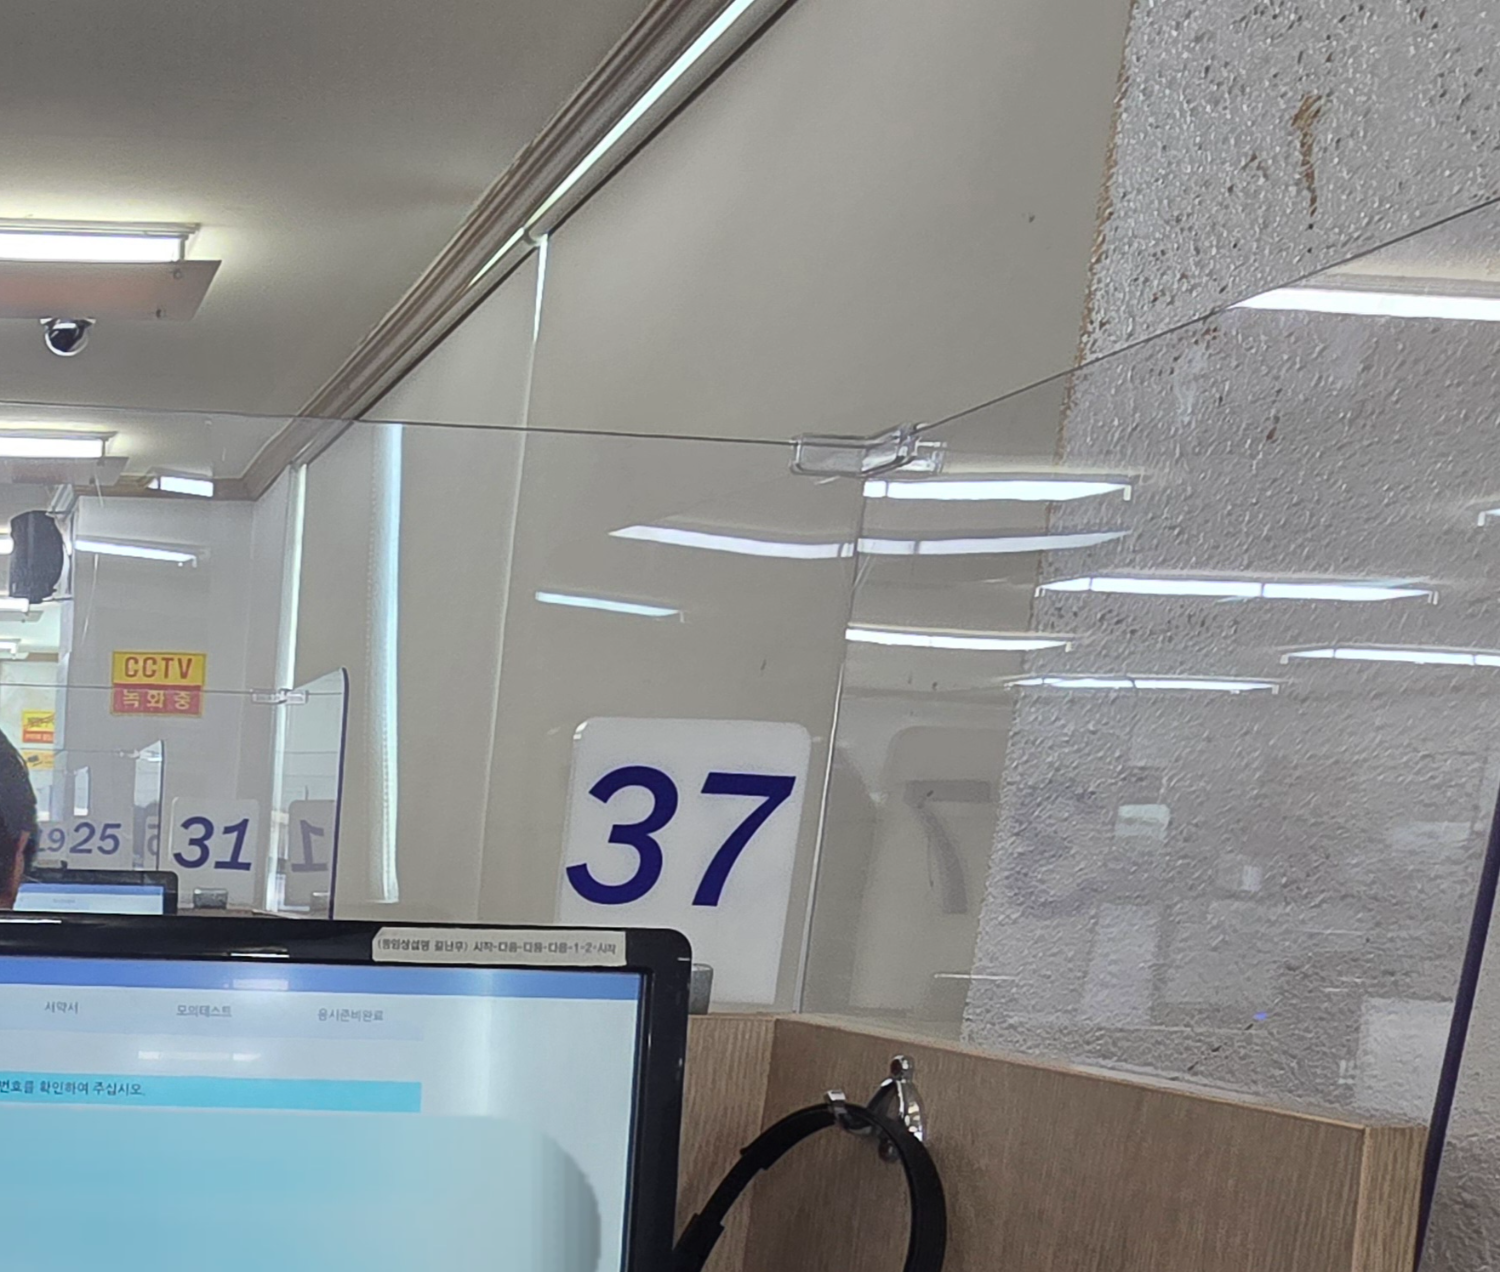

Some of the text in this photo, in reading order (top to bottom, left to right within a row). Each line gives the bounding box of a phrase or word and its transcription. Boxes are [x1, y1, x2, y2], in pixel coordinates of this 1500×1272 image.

[124, 656, 193, 679] CCTV
[69, 822, 122, 855] 25
[173, 816, 252, 871] 31
[566, 765, 796, 906] 37
[176, 1004, 232, 1018] 모의테스트
[317, 1007, 384, 1022] 응시준비완료
[39, 1080, 89, 1096] 확인하여
